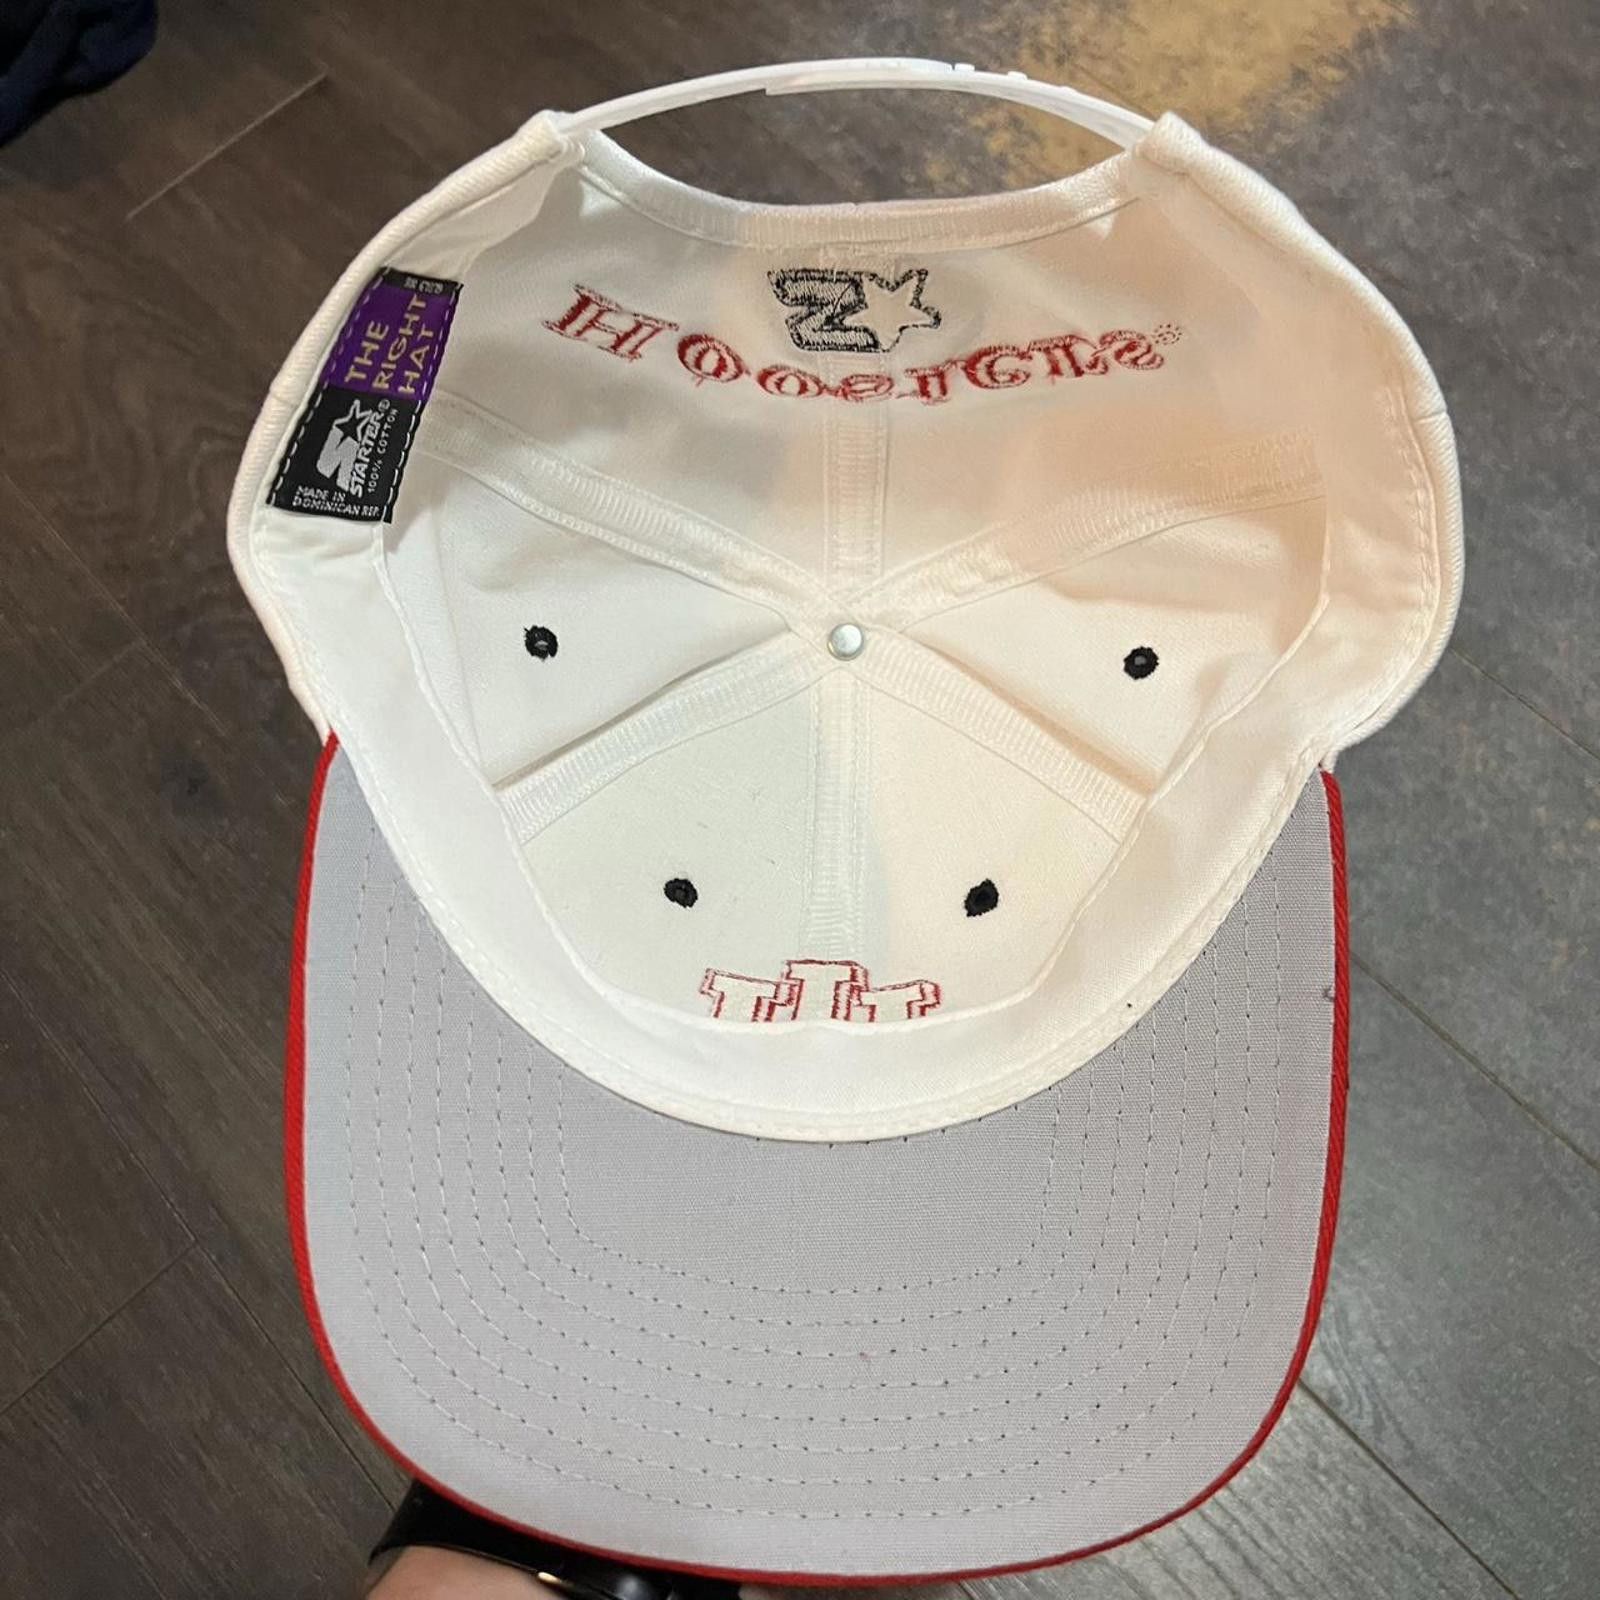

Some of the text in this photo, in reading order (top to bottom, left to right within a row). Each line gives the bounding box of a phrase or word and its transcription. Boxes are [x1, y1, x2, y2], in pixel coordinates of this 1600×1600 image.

[344, 321, 389, 382] THE
[372, 294, 426, 389] RIGHT
[398, 323, 434, 394] HAT
[367, 408, 398, 493] 100% COTTON
[292, 496, 361, 516] DOMINICAN
[296, 485, 346, 502] MADE IN
